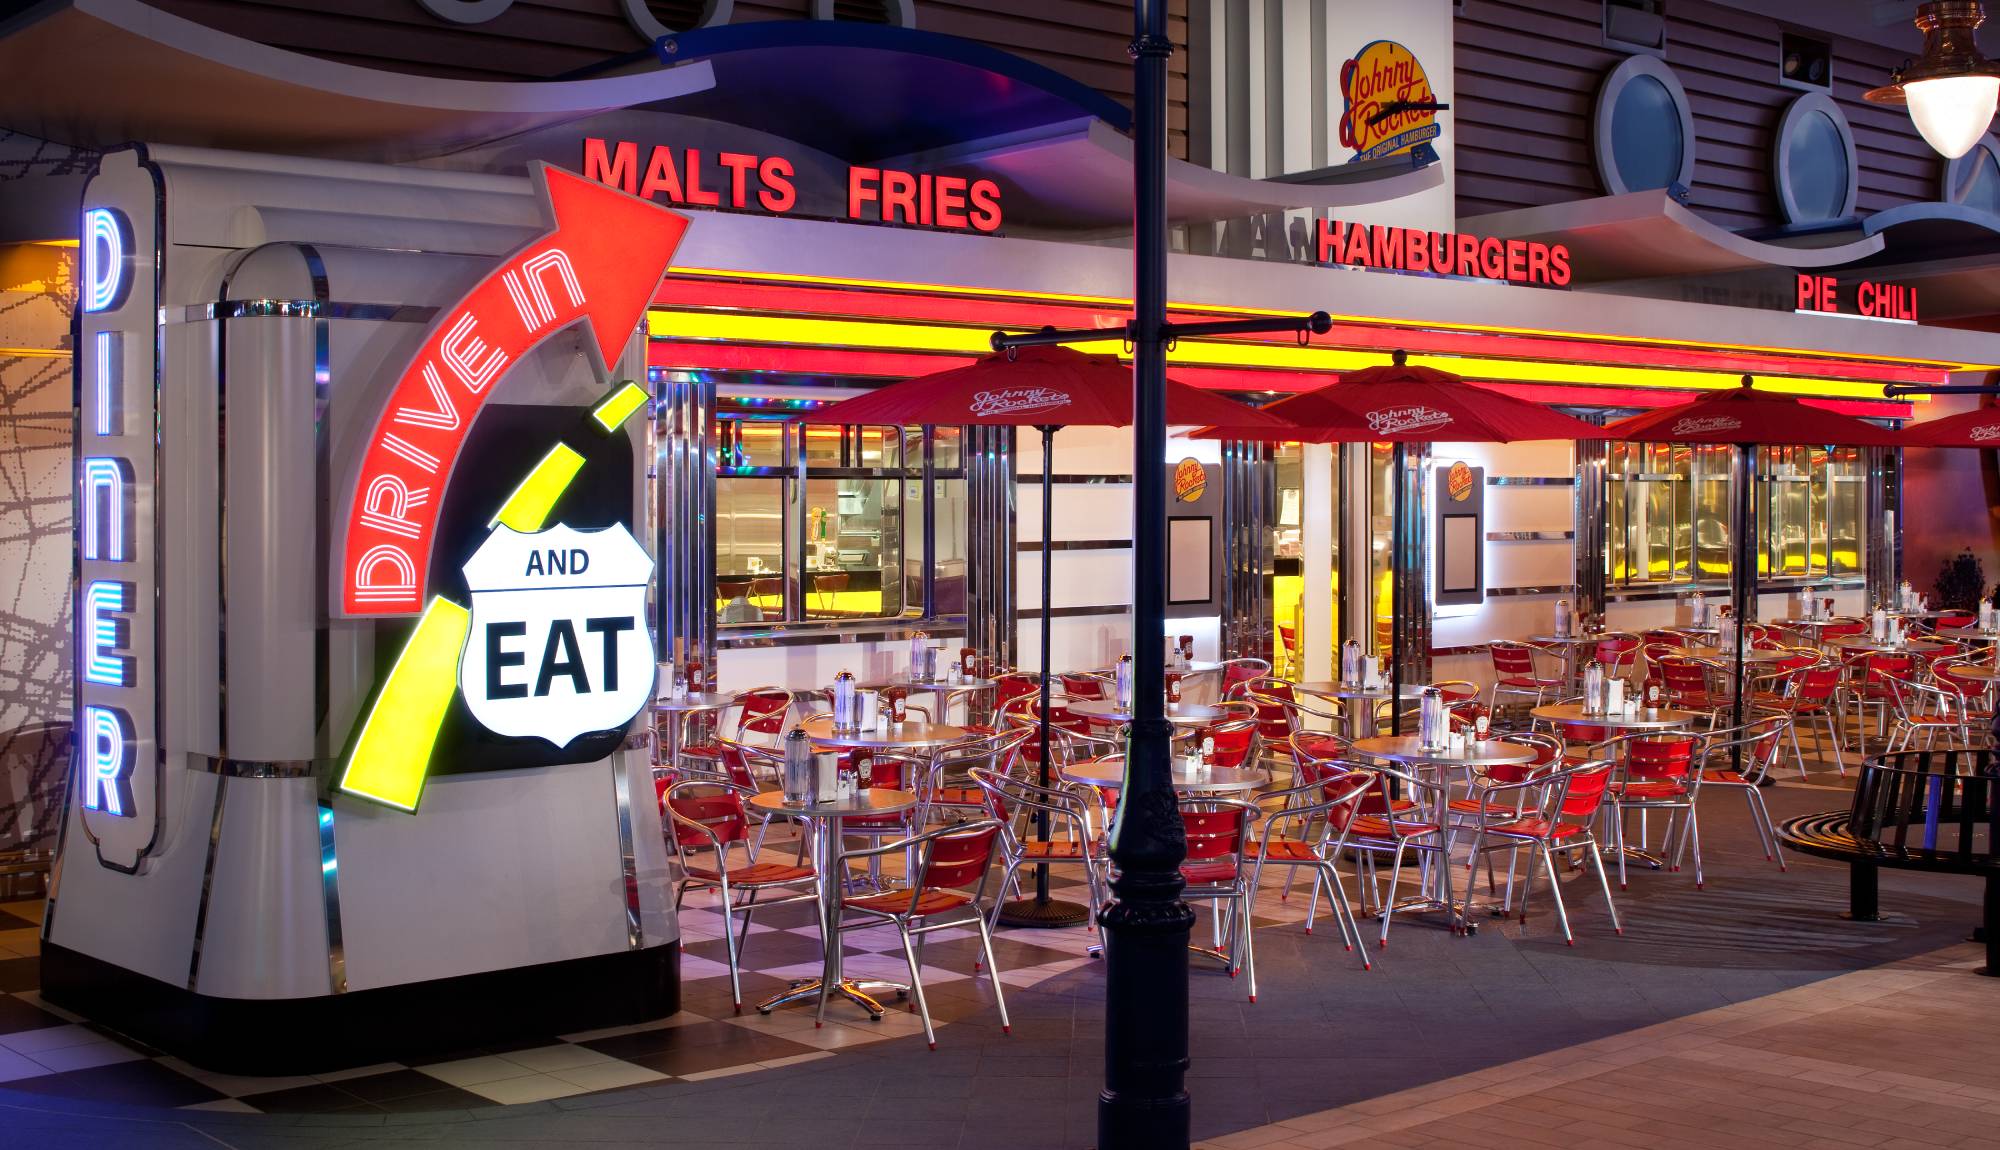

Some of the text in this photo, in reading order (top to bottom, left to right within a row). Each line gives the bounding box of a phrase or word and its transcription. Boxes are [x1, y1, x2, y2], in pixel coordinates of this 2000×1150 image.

[1339, 56, 1423, 147] Johnny
[1372, 136, 1399, 158] ORIGINAL
[1401, 125, 1437, 147] HAMBURGER
[584, 137, 1001, 232] MALTS FRIES
[1316, 217, 1571, 285] HAMBURGERS
[1796, 273, 1838, 312] PIE
[1857, 281, 1919, 321] CHILI
[970, 388, 1053, 411] Johnny
[987, 393, 1069, 410] Rockets
[1366, 406, 1435, 431] Johnny
[1380, 412, 1449, 429] Rockets
[354, 311, 509, 603] DRIVE
[84, 206, 130, 816] DINER
[525, 548, 590, 577] AND
[486, 616, 635, 700] EAT
